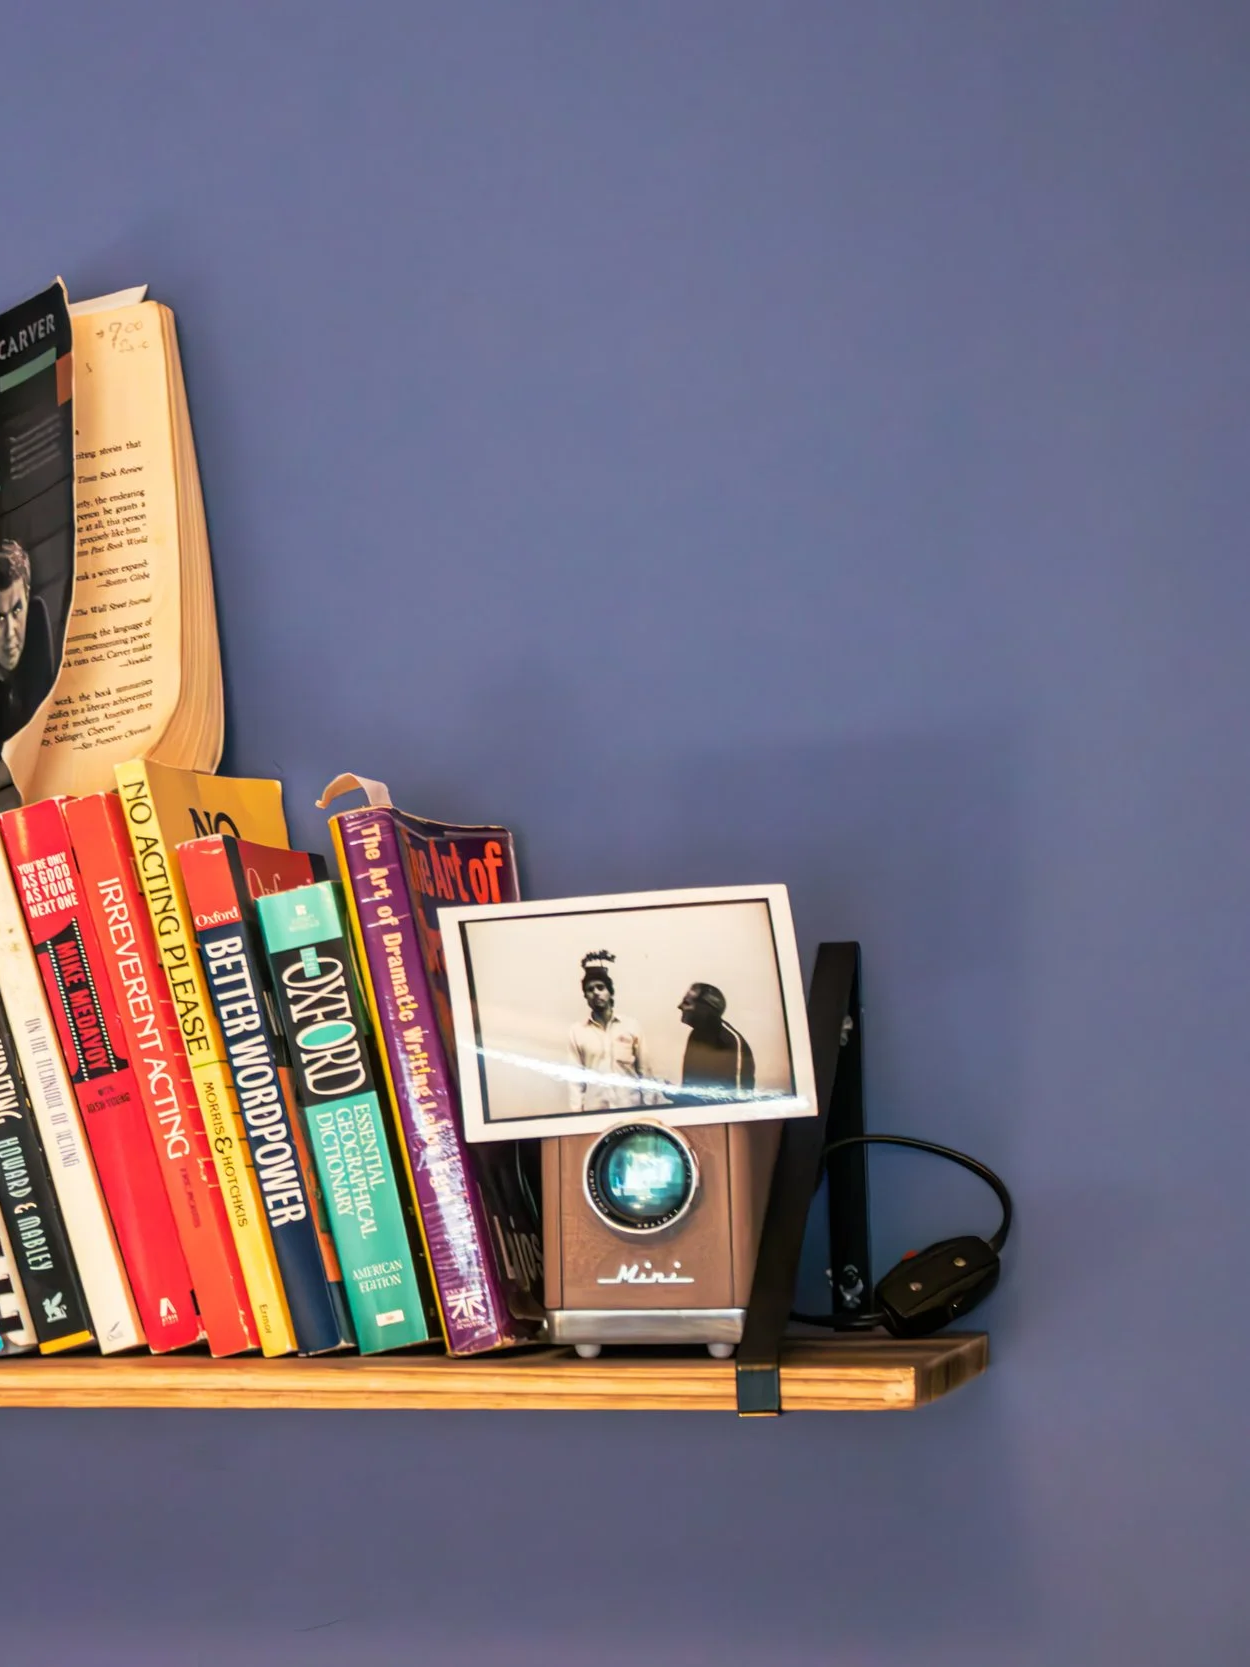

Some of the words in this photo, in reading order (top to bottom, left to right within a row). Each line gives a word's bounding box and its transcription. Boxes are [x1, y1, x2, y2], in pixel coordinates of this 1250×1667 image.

[126, 440, 141, 449] that
[95, 496, 107, 505] the
[110, 489, 145, 502] endearing
[122, 780, 152, 824] NO
[189, 807, 241, 839] NO
[360, 823, 382, 861] The
[17, 858, 47, 875] YOU'RE
[46, 851, 67, 868] ONLY
[21, 874, 38, 890] AS
[38, 863, 71, 885] GOOD
[429, 838, 470, 903] Art
[468, 840, 503, 905] of
[25, 888, 43, 905] AS
[41, 878, 75, 899] YOUR
[135, 835, 180, 937] ACTING
[369, 867, 393, 899] Art
[29, 899, 57, 918] NEXT
[56, 892, 79, 910] ONE
[195, 905, 239, 928] Oxford
[377, 905, 400, 927] of
[204, 936, 261, 1035] BETTER
[383, 932, 419, 1022] Dramatic
[54, 940, 80, 985] MIKE
[68, 990, 109, 1070] MEDAVOY
[97, 877, 165, 1052] IRREVERENT
[143, 1057, 190, 1159] ACTING
[163, 945, 210, 1056] PLEASE
[25, 1018, 42, 1034] ON
[29, 1036, 49, 1054] THE
[282, 956, 367, 1097] OXFORD
[51, 1112, 68, 1125] OF
[203, 1081, 227, 1135] MORRIS
[56, 1129, 80, 1168] ACTING
[214, 1137, 233, 1157] &
[229, 1038, 307, 1228] WORDPOWER
[354, 1103, 386, 1192] ESSENTIAL
[315, 1113, 355, 1217] DICTIONARY
[335, 1107, 377, 1239] GEOGRAPHICAL
[225, 1156, 248, 1228] HOTCHKIS
[16, 1217, 54, 1271] MABLEY
[352, 1259, 403, 1281] AMERICAN
[358, 1274, 403, 1294] EDITION
[606, 1261, 688, 1284] Mini
